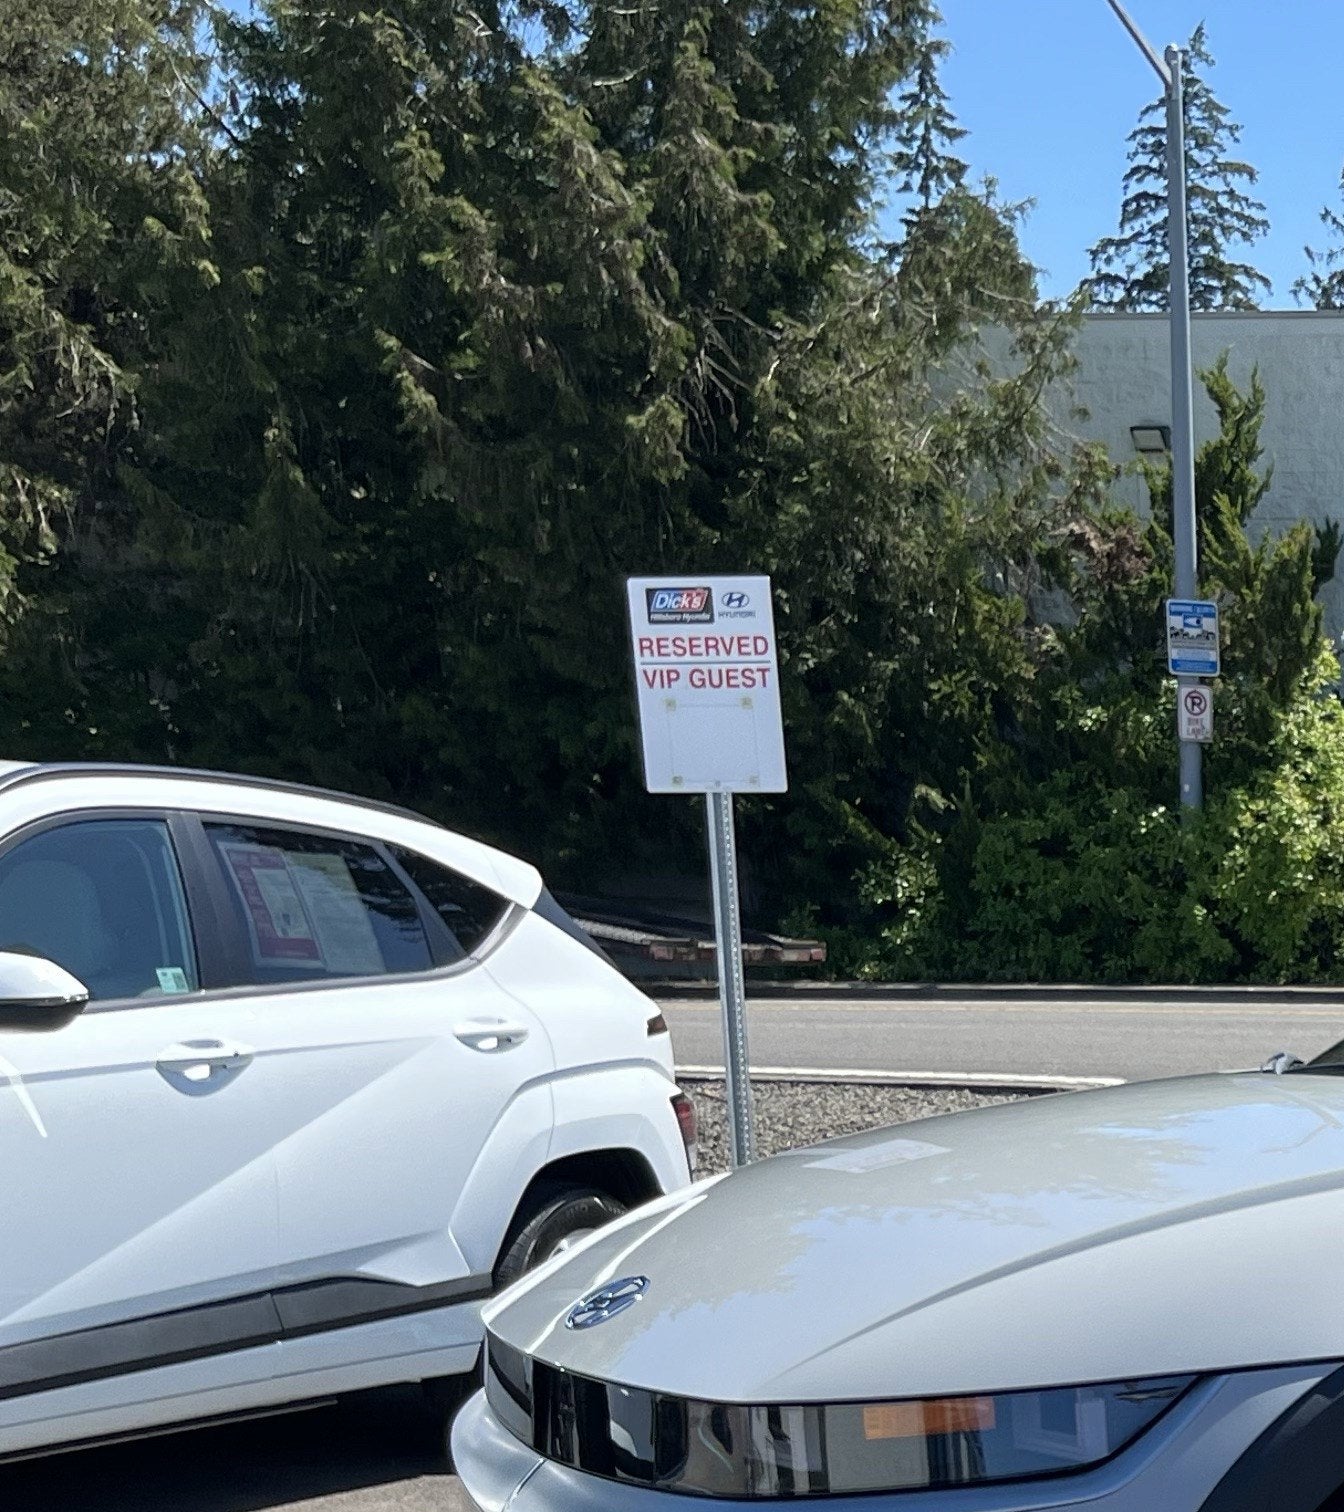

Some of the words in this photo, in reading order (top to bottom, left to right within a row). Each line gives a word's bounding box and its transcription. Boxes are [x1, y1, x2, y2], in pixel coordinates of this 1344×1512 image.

[639, 636, 769, 657] RESERVED
[642, 668, 681, 689] VIP
[689, 668, 770, 689] GUEST
